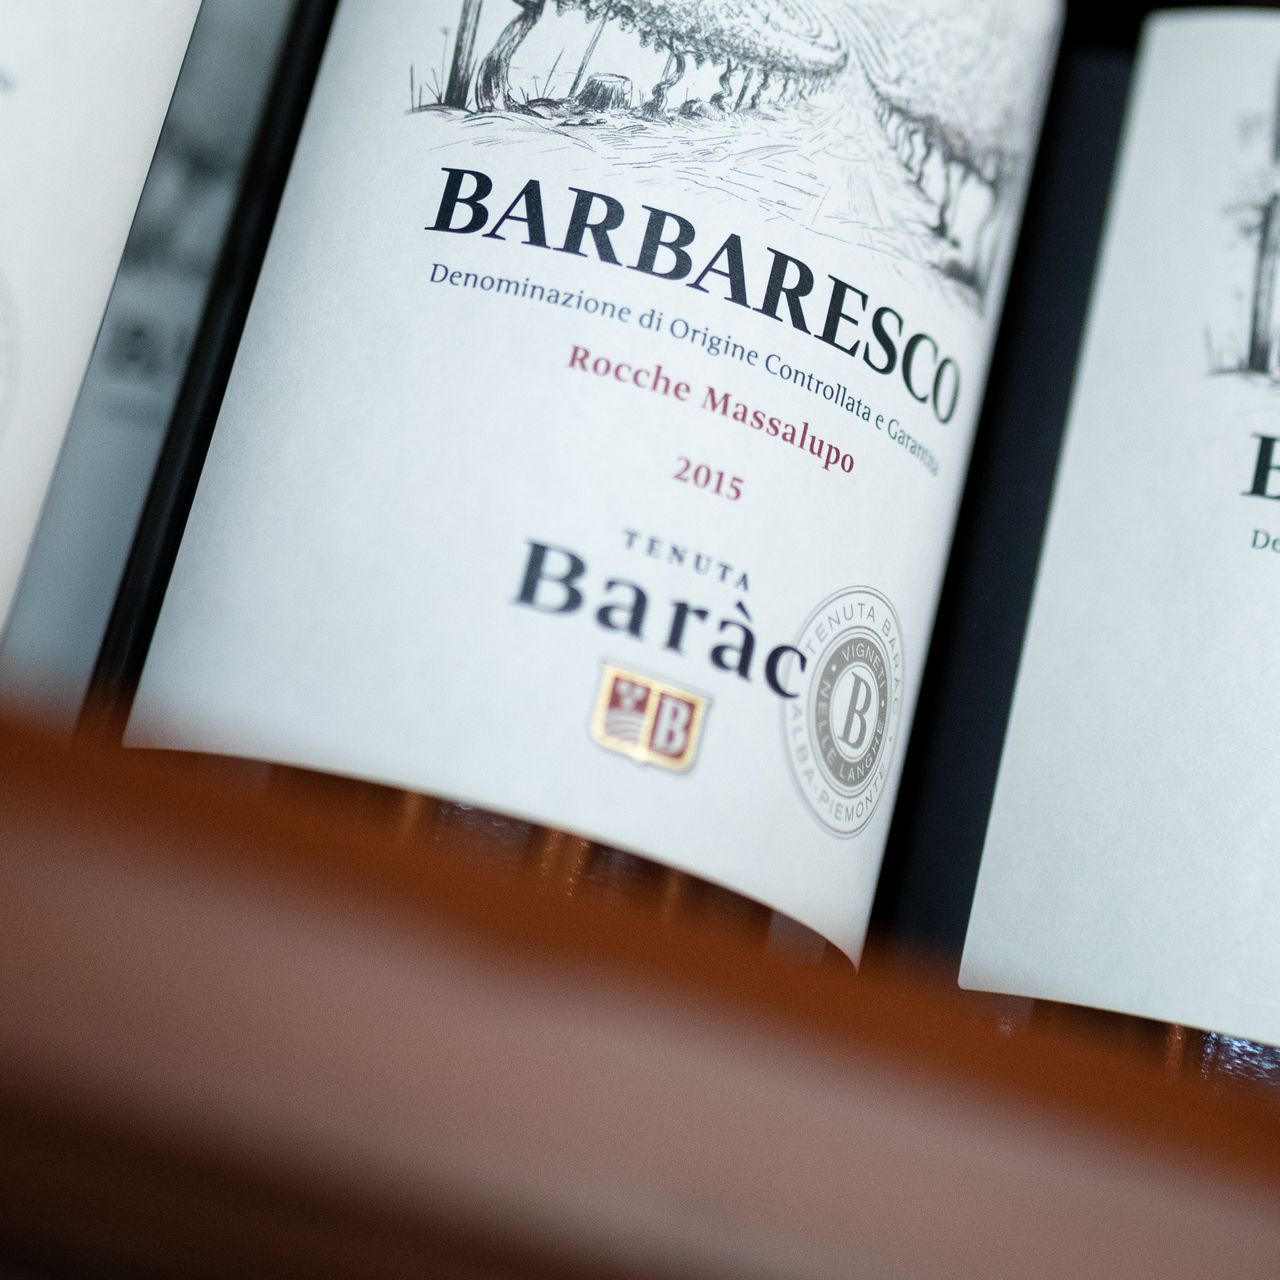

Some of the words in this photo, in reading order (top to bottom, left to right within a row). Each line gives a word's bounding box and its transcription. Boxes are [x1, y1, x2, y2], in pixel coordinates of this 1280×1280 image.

[424, 167, 961, 424] BARBARESCO
[430, 263, 631, 322] Denominazione
[638, 308, 662, 332] di
[670, 318, 758, 367] Origine
[765, 354, 871, 422] Controllata
[875, 414, 884, 430] e
[568, 344, 691, 401] Rocche
[702, 385, 855, 473] Massalupo
[672, 456, 745, 502] 2015
[624, 529, 750, 592] TENUTA
[511, 538, 808, 699] Baràc
[805, 603, 877, 658] TENUTA
[841, 643, 886, 688] VIGNETI
[653, 691, 691, 758] B
[838, 671, 872, 750] B
[839, 720, 885, 782] LANGHE
